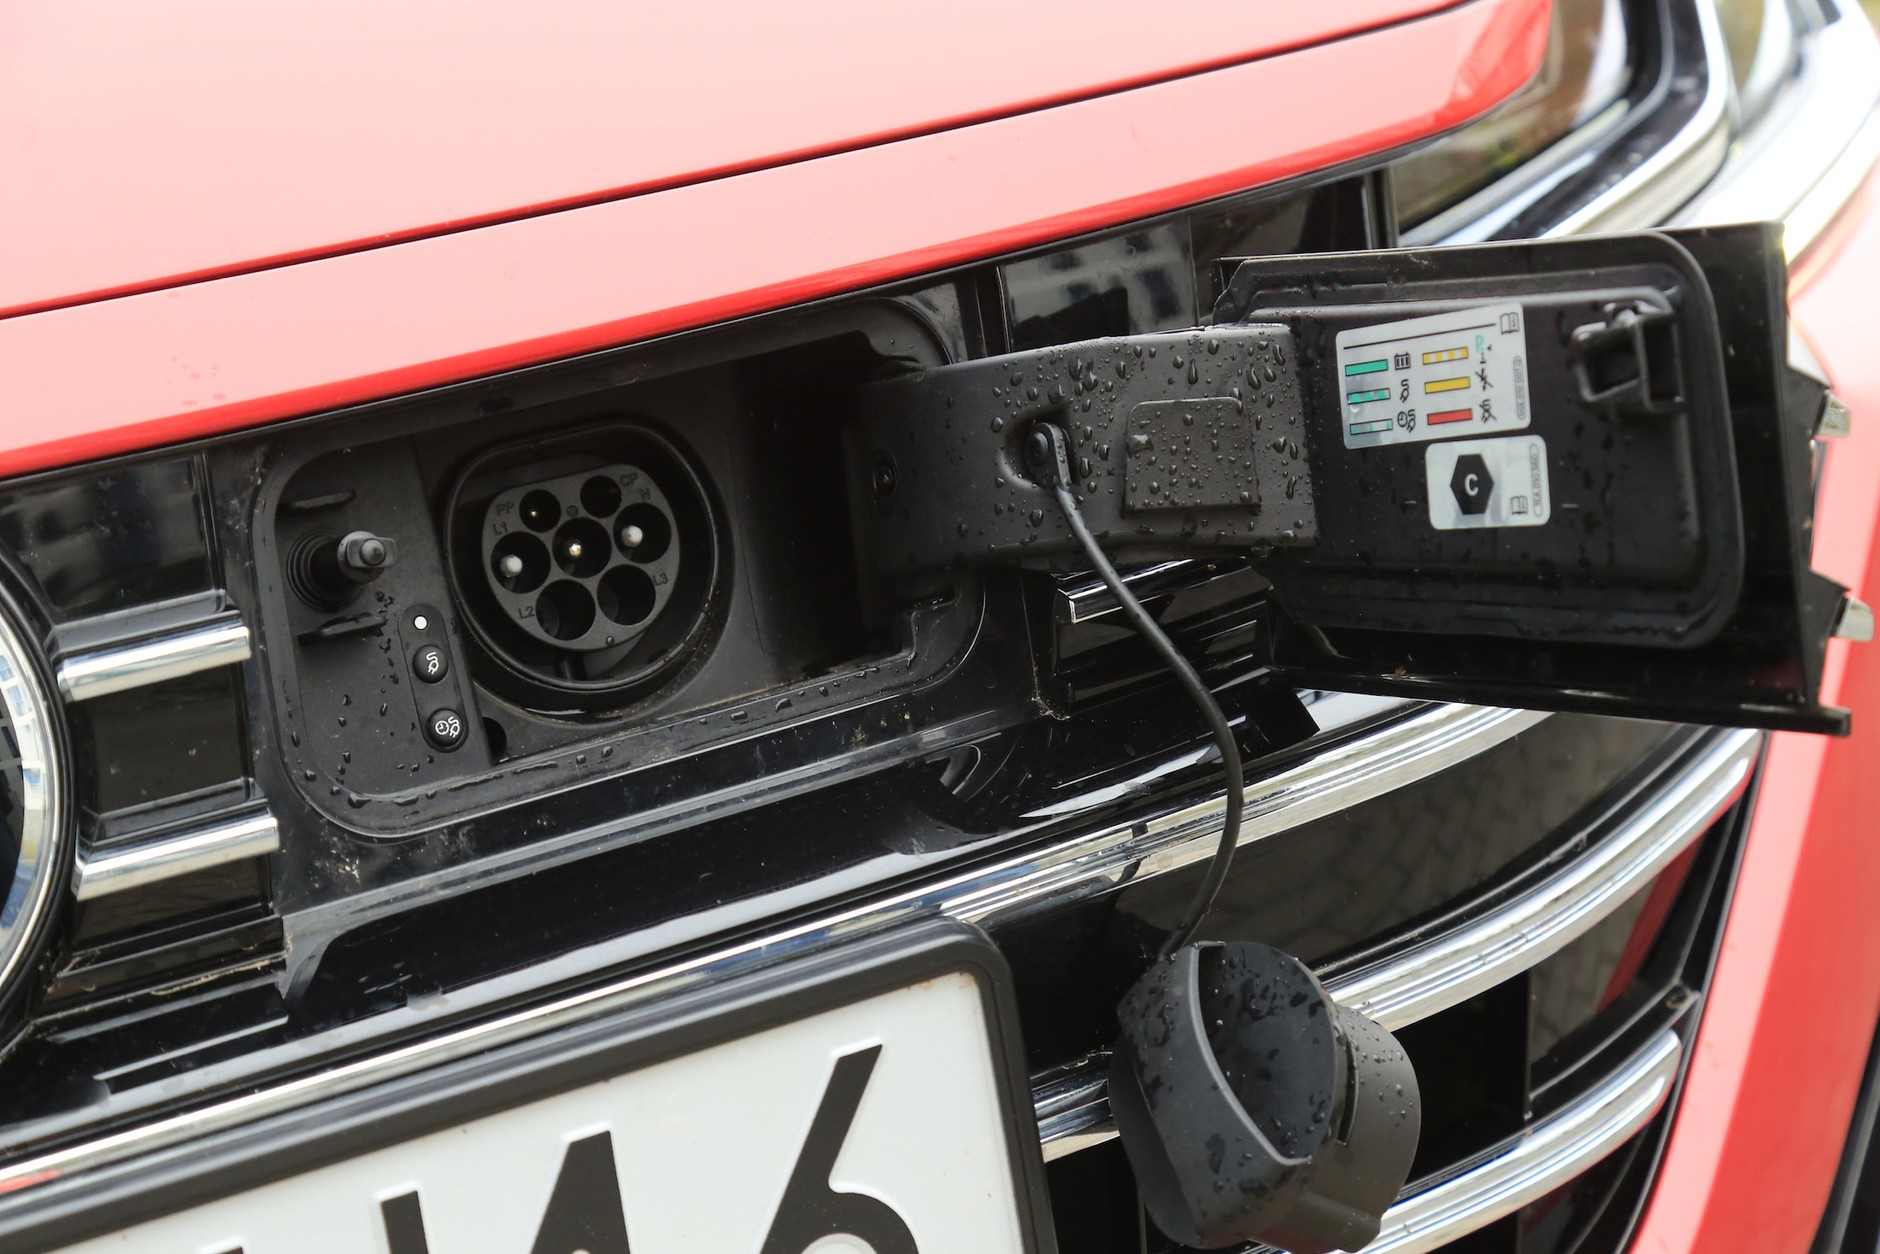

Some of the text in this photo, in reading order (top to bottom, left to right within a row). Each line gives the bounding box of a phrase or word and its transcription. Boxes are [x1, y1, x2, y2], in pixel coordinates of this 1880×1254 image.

[619, 472, 638, 487] CP
[1464, 473, 1479, 496] C
[496, 501, 514, 516] PP
[492, 521, 508, 536] L1
[652, 572, 669, 587] L3
[518, 605, 535, 620] L2
